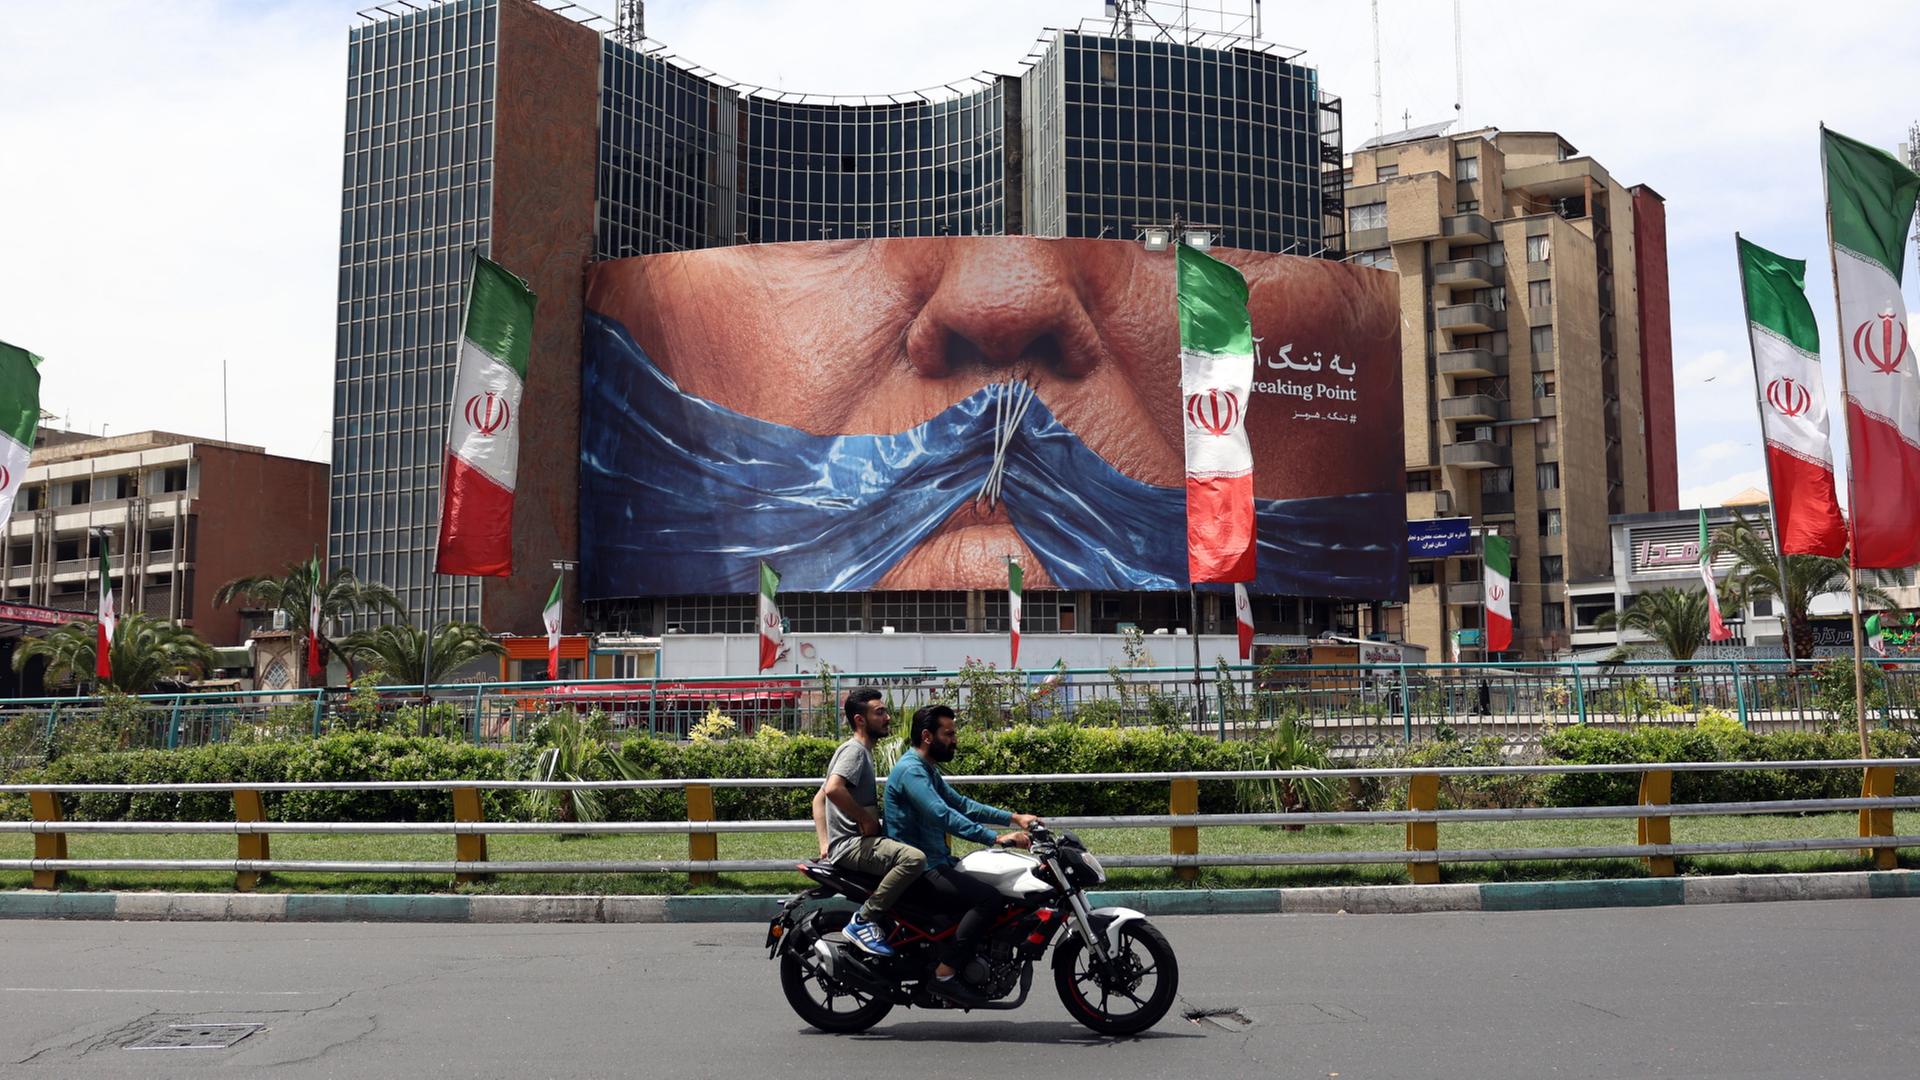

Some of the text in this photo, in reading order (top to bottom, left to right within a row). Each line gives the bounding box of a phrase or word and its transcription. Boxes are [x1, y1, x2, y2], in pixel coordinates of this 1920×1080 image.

[1268, 343, 1322, 371] تنگ
[1329, 354, 1357, 382] به
[1252, 379, 1357, 401] reaking Point
